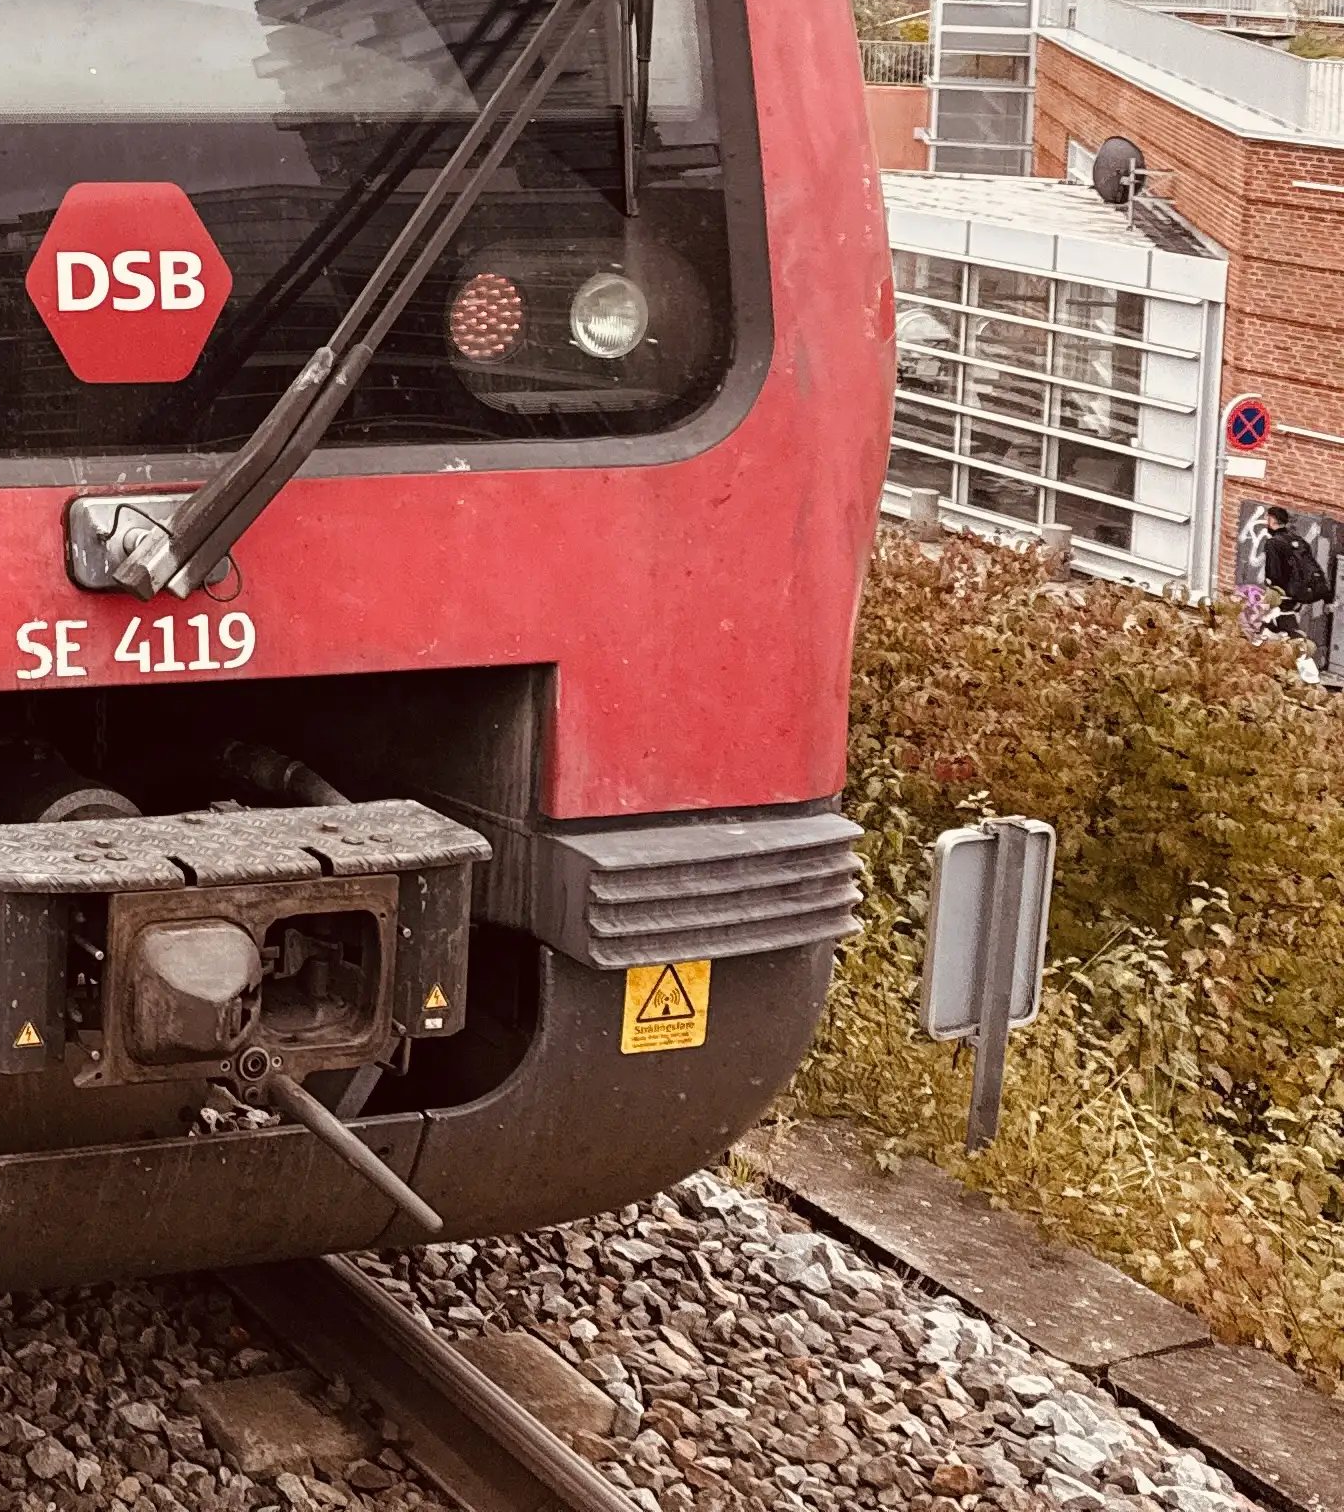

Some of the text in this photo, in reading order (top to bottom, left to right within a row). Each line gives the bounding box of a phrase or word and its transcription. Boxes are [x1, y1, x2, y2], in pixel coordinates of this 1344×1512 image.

[55, 250, 206, 313] DSB
[15, 611, 257, 680] SE 4119
